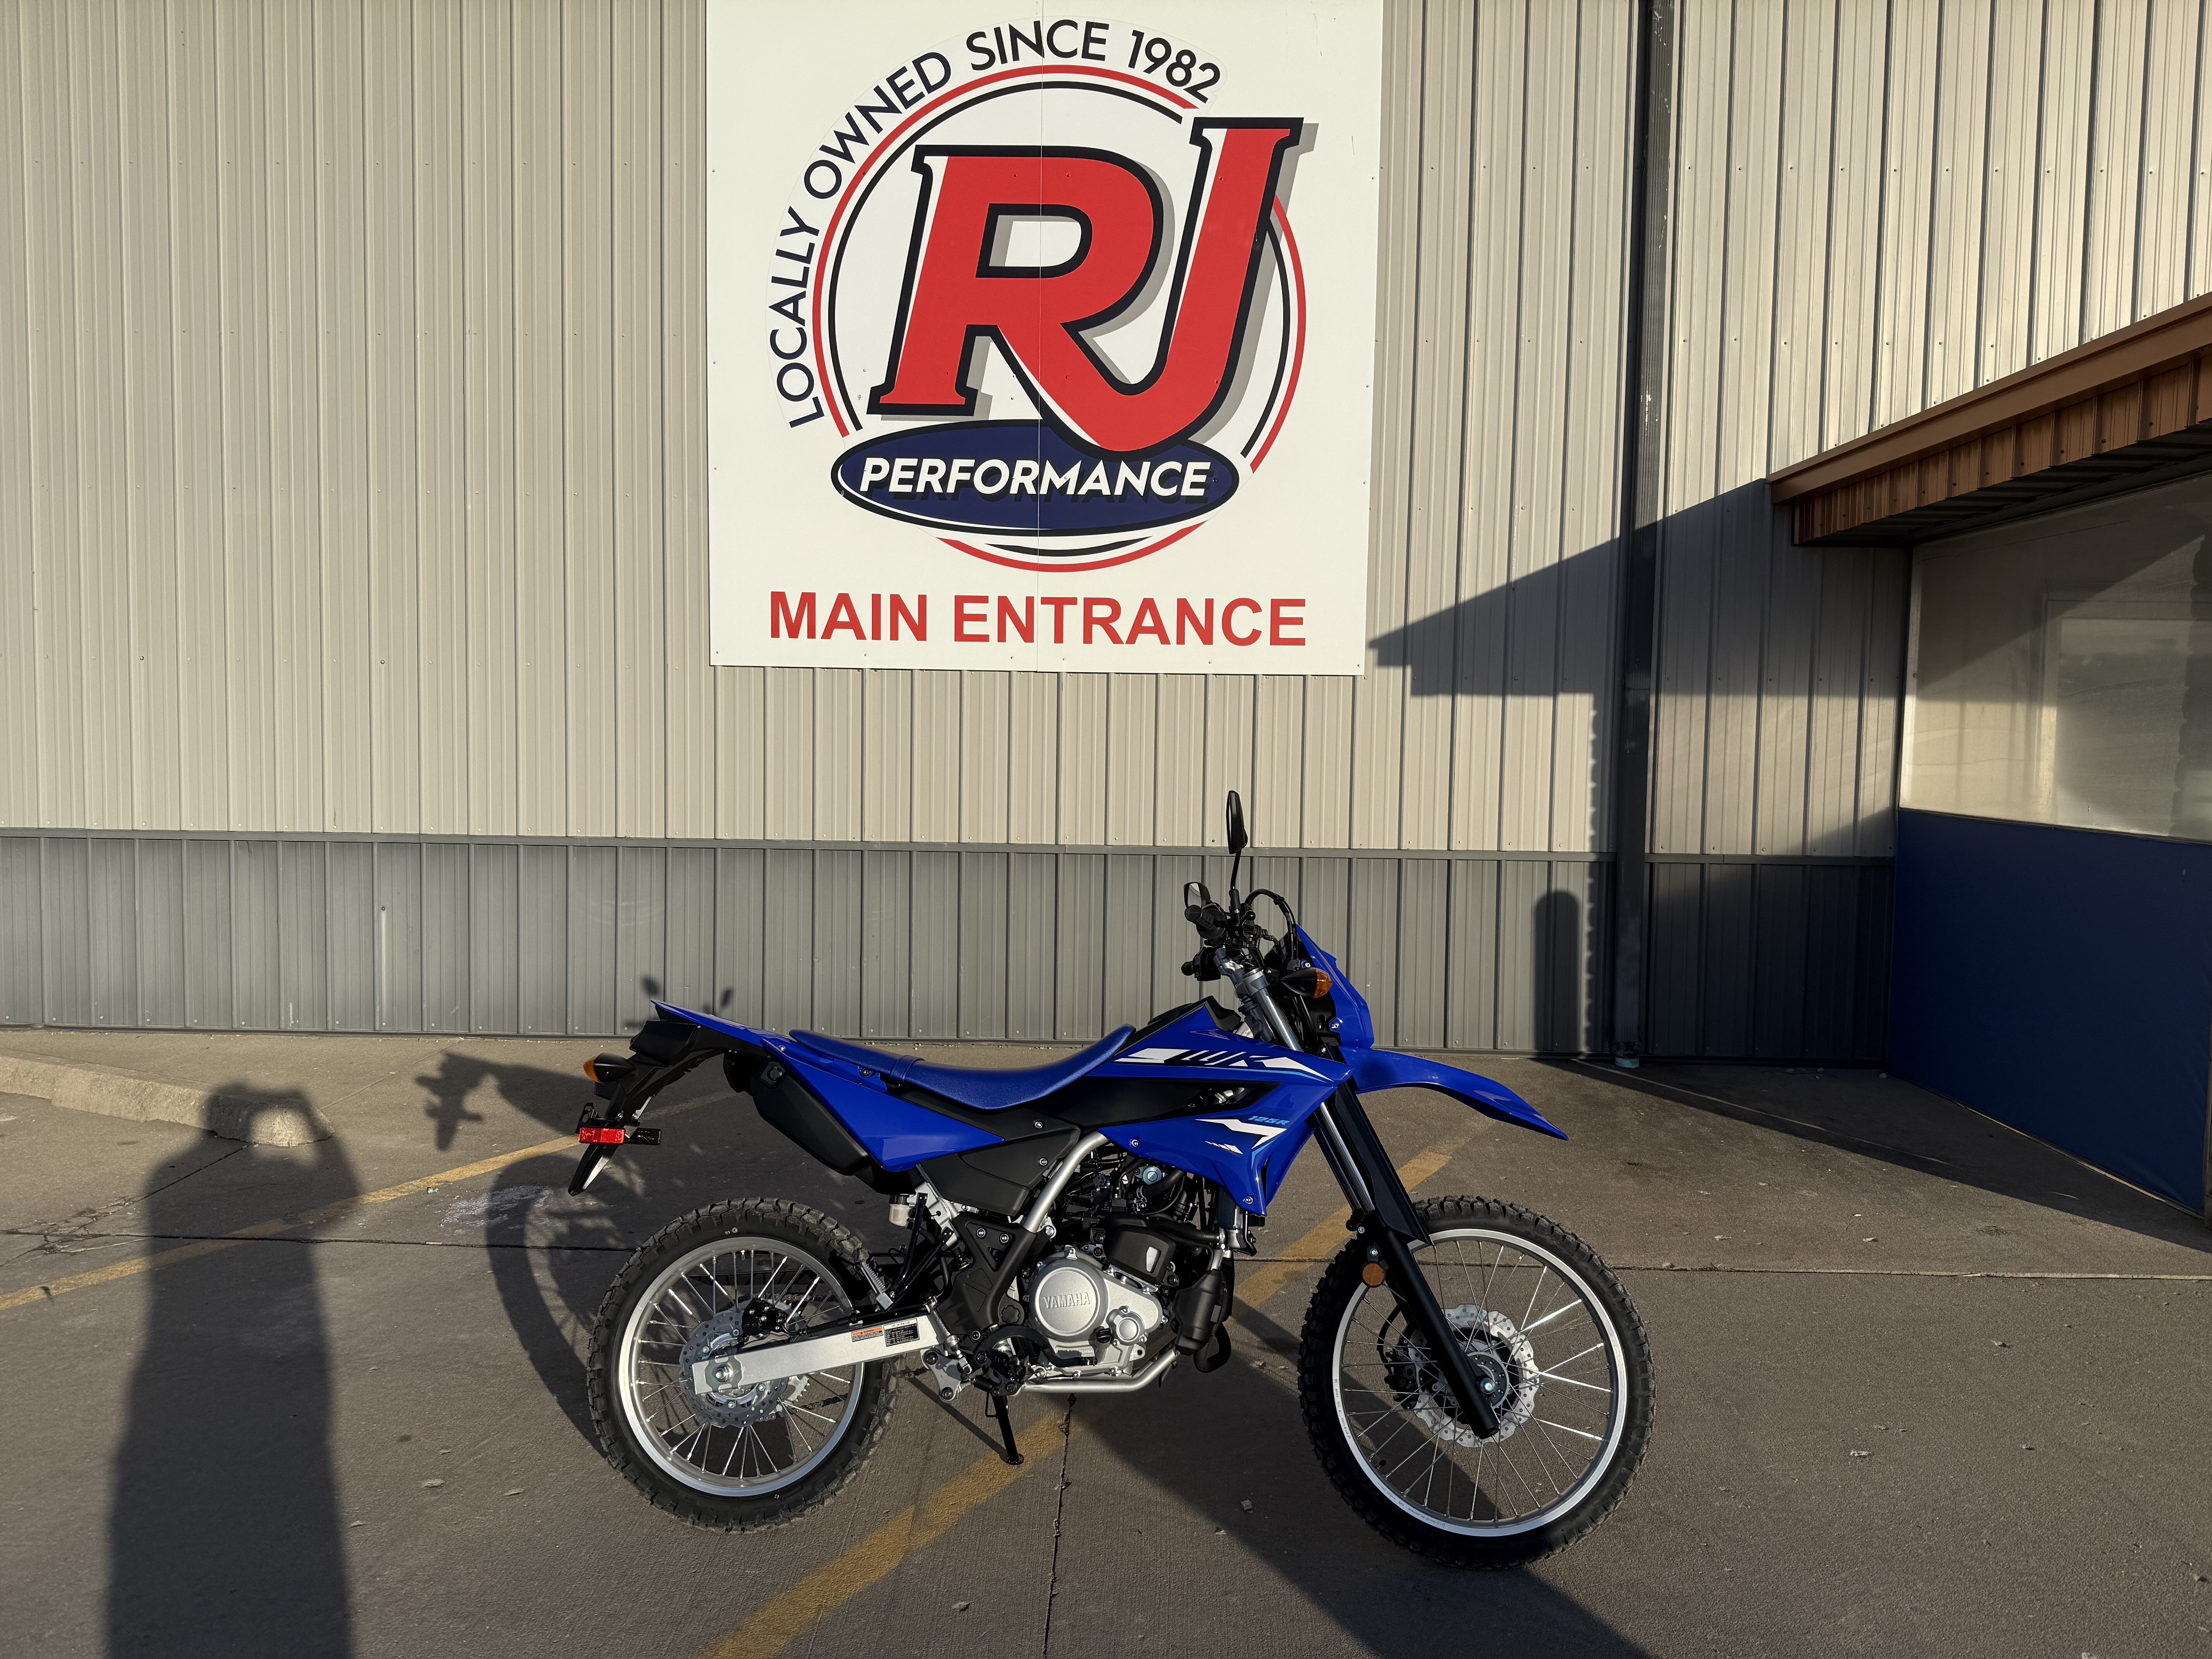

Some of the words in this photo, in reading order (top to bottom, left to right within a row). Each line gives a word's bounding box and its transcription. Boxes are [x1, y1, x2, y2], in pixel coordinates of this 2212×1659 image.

[769, 206, 824, 428] LOCALLY
[804, 52, 951, 199] OWNED
[967, 20, 1109, 70] SINCE
[1128, 30, 1220, 103] 1982
[866, 117, 1304, 461] RJ
[860, 459, 1211, 496] PERFORMANCE
[770, 591, 927, 641] MAIN
[954, 595, 1305, 646] ENTRANCE
[1248, 1116, 1290, 1125] 125R
[1044, 1292, 1090, 1309] YAMAHA
